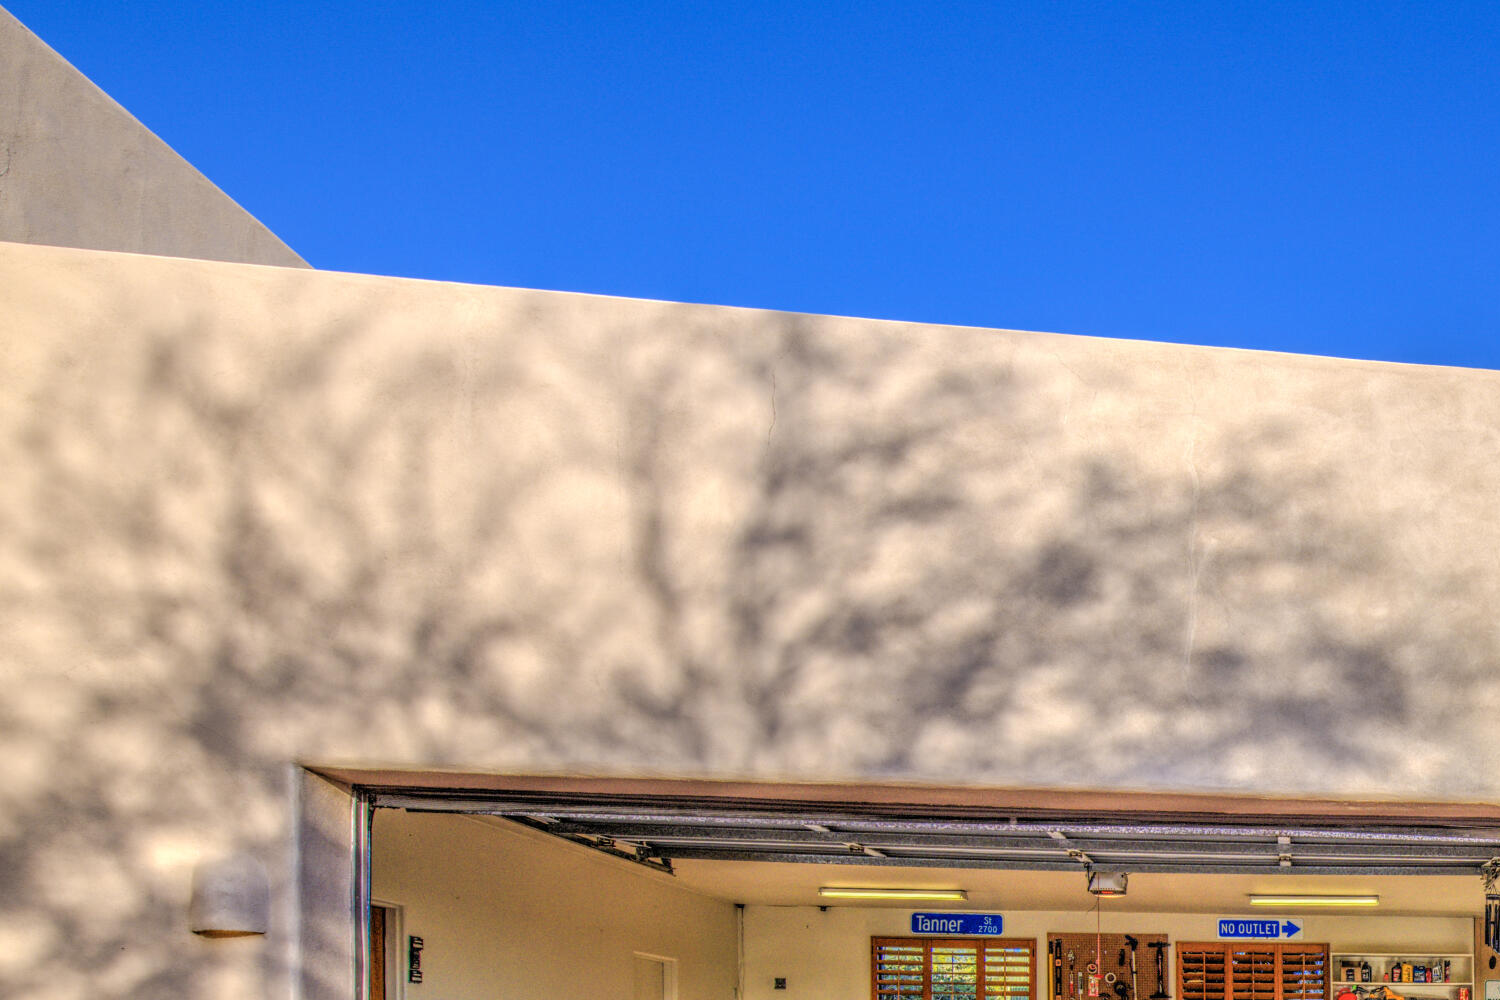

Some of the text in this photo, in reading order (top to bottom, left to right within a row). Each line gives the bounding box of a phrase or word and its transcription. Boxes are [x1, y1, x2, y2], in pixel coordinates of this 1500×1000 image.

[916, 915, 992, 932] Tanner St
[1221, 923, 1277, 934] NO OUTLET
